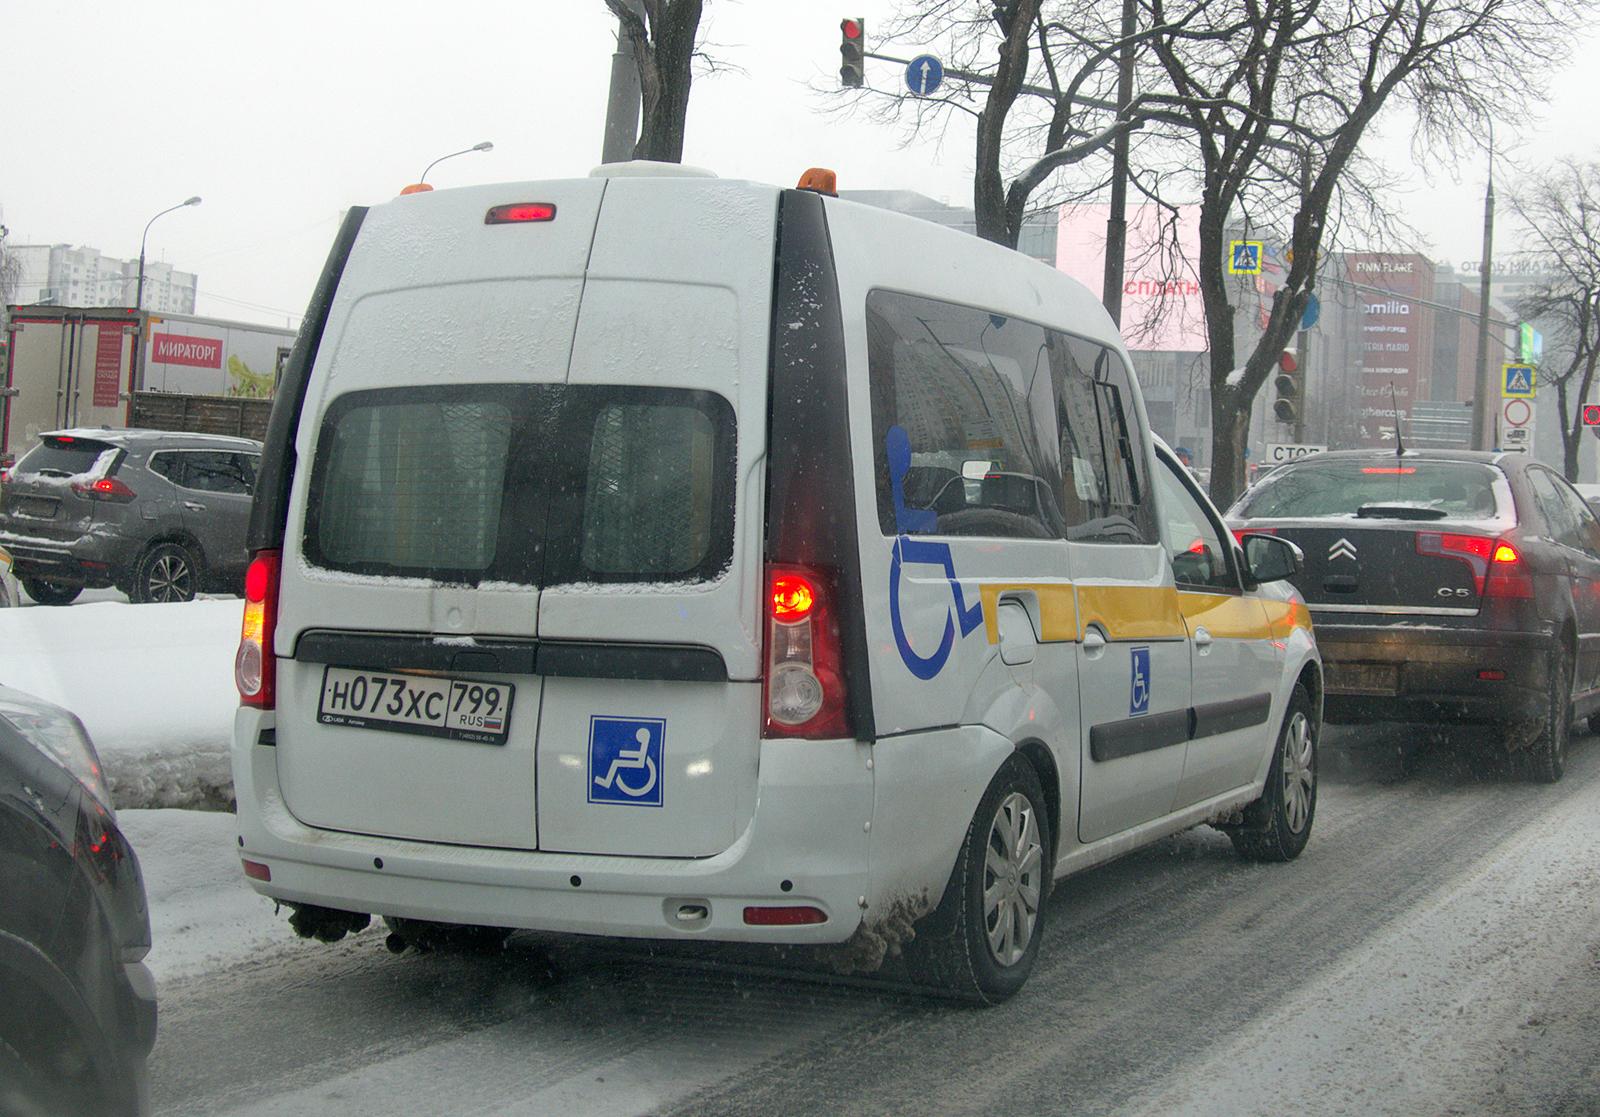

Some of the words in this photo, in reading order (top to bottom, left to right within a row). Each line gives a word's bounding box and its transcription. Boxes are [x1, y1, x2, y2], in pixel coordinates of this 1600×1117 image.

[1461, 260, 1505, 272] ОТЛЬ
[158, 340, 217, 361] МИРАТОРГ
[1437, 587, 1470, 598] C5
[453, 683, 500, 716] 799
[459, 714, 483, 727] RUS
